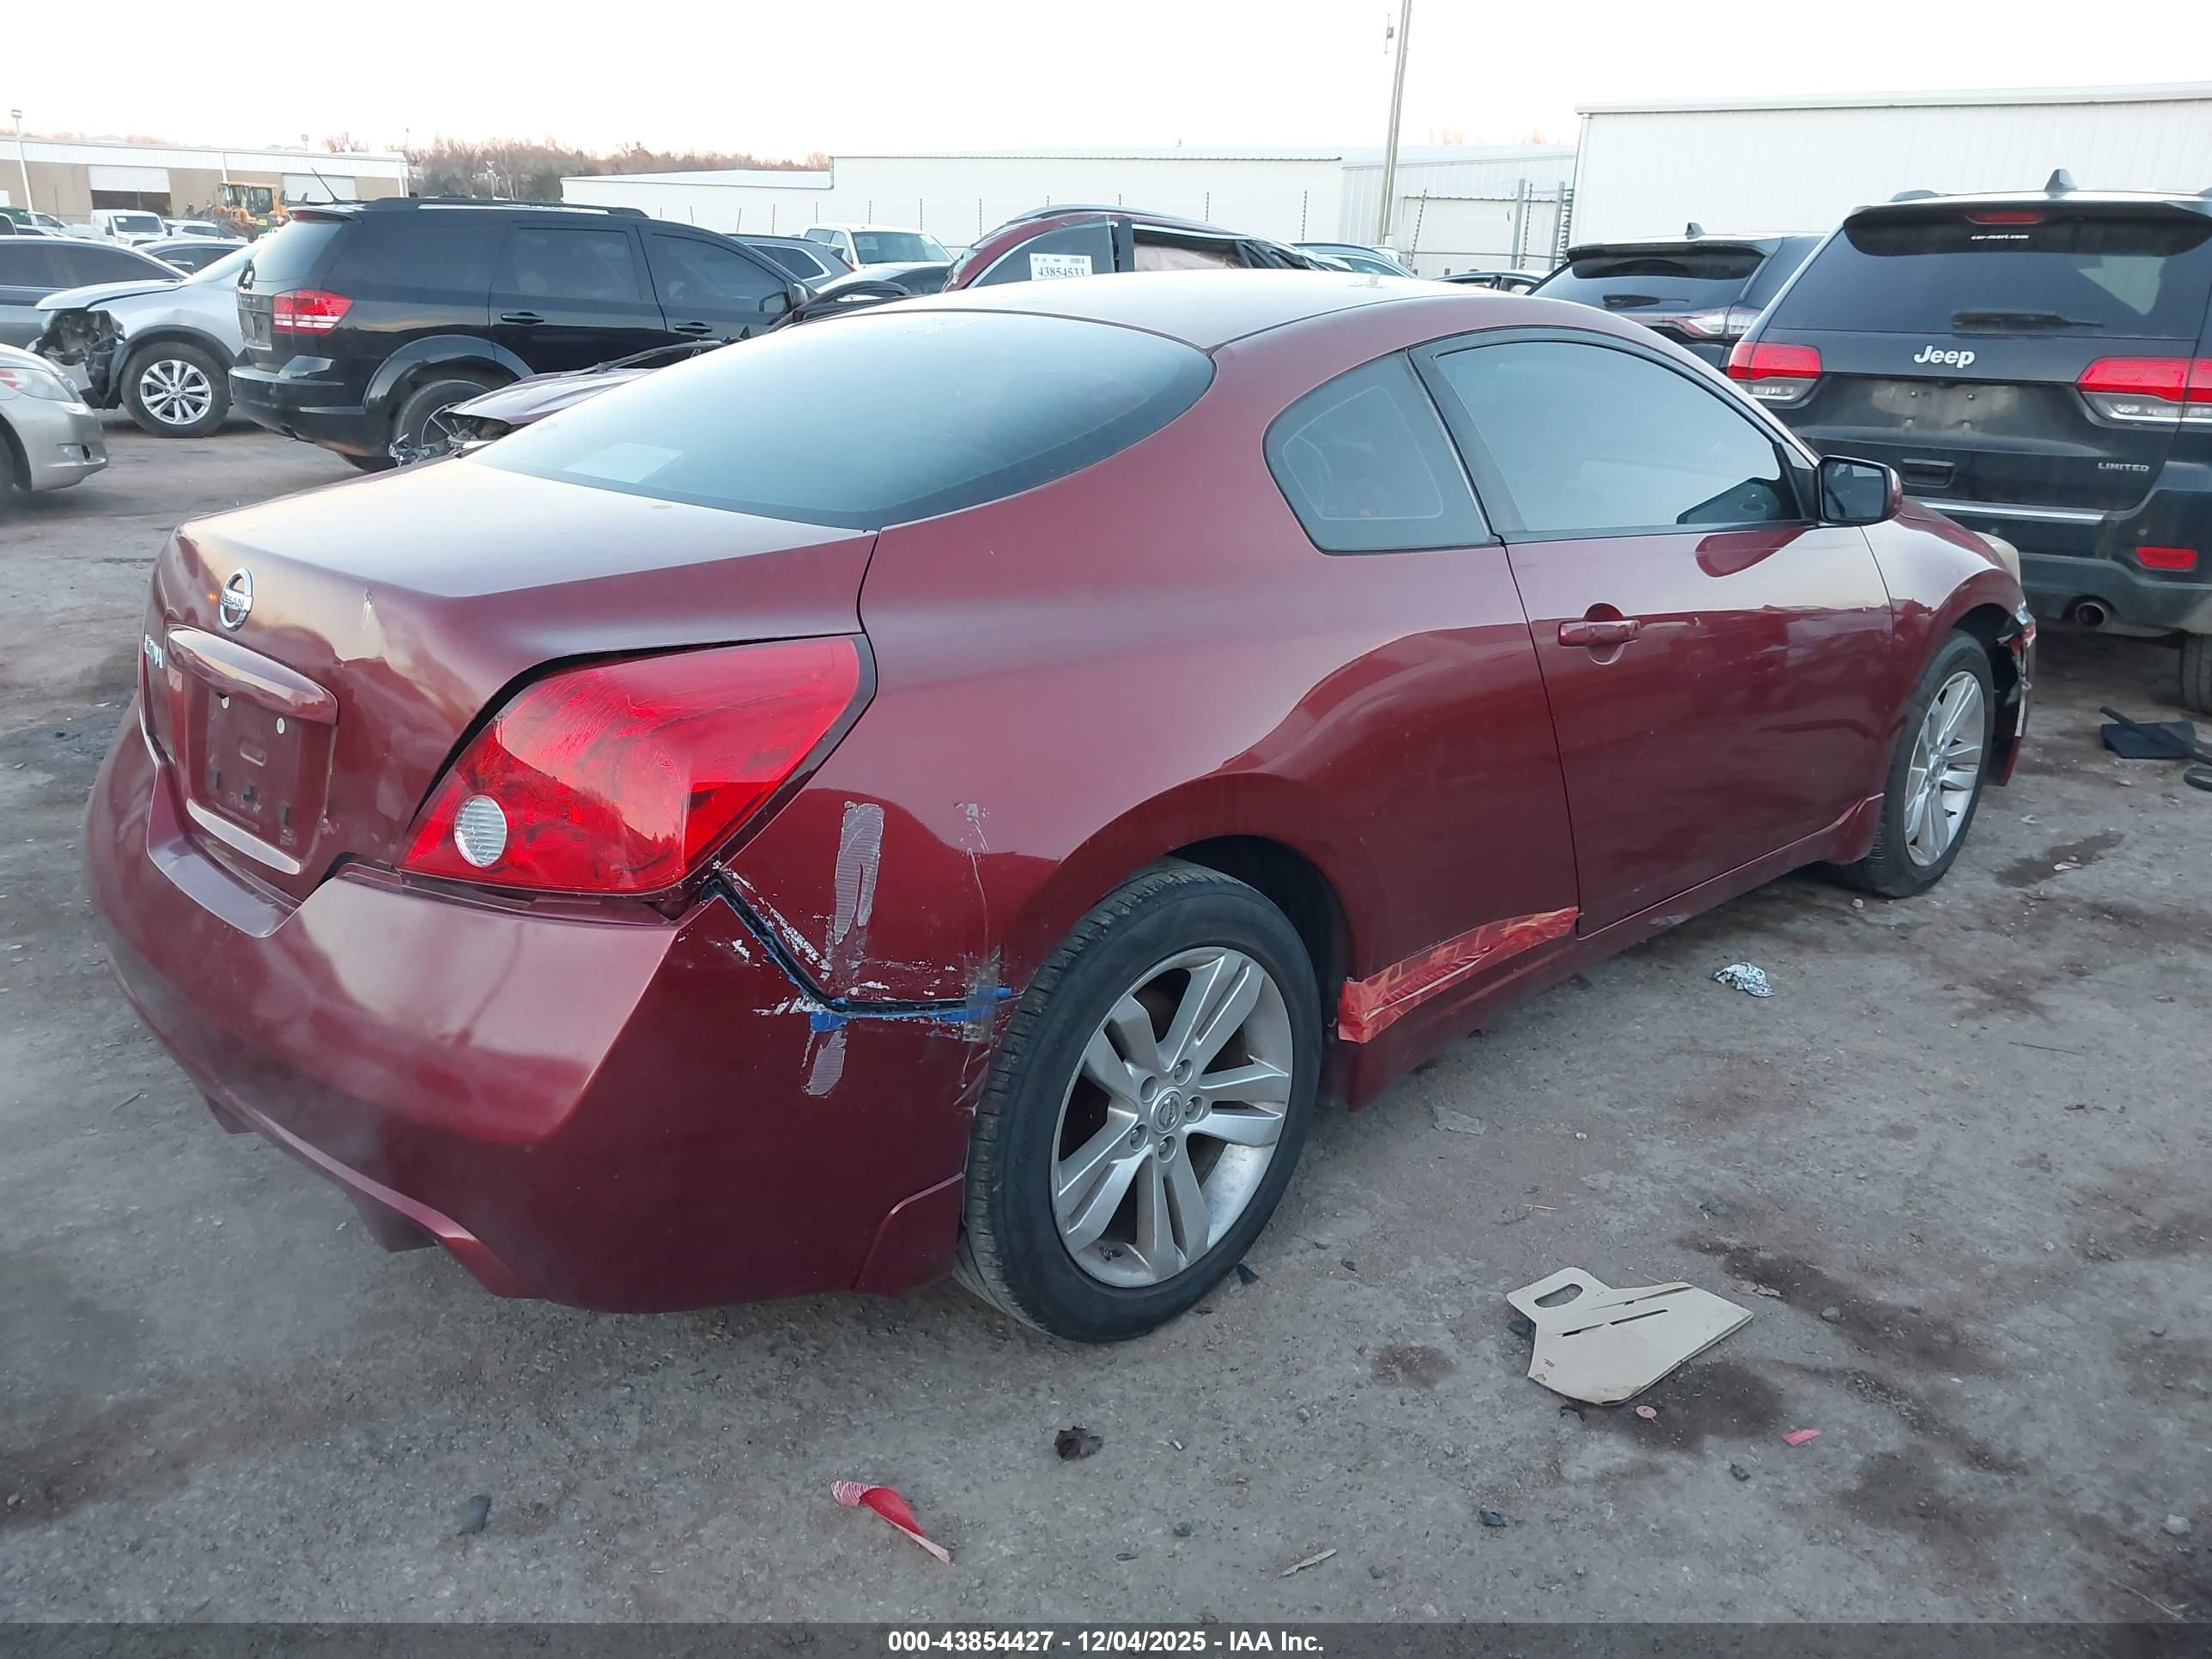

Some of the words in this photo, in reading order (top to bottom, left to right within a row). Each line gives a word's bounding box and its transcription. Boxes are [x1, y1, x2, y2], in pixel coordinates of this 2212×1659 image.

[1037, 267, 1085, 278] 43854533
[1913, 344, 1976, 369] Jeep
[2097, 462, 2150, 472] LIMITED
